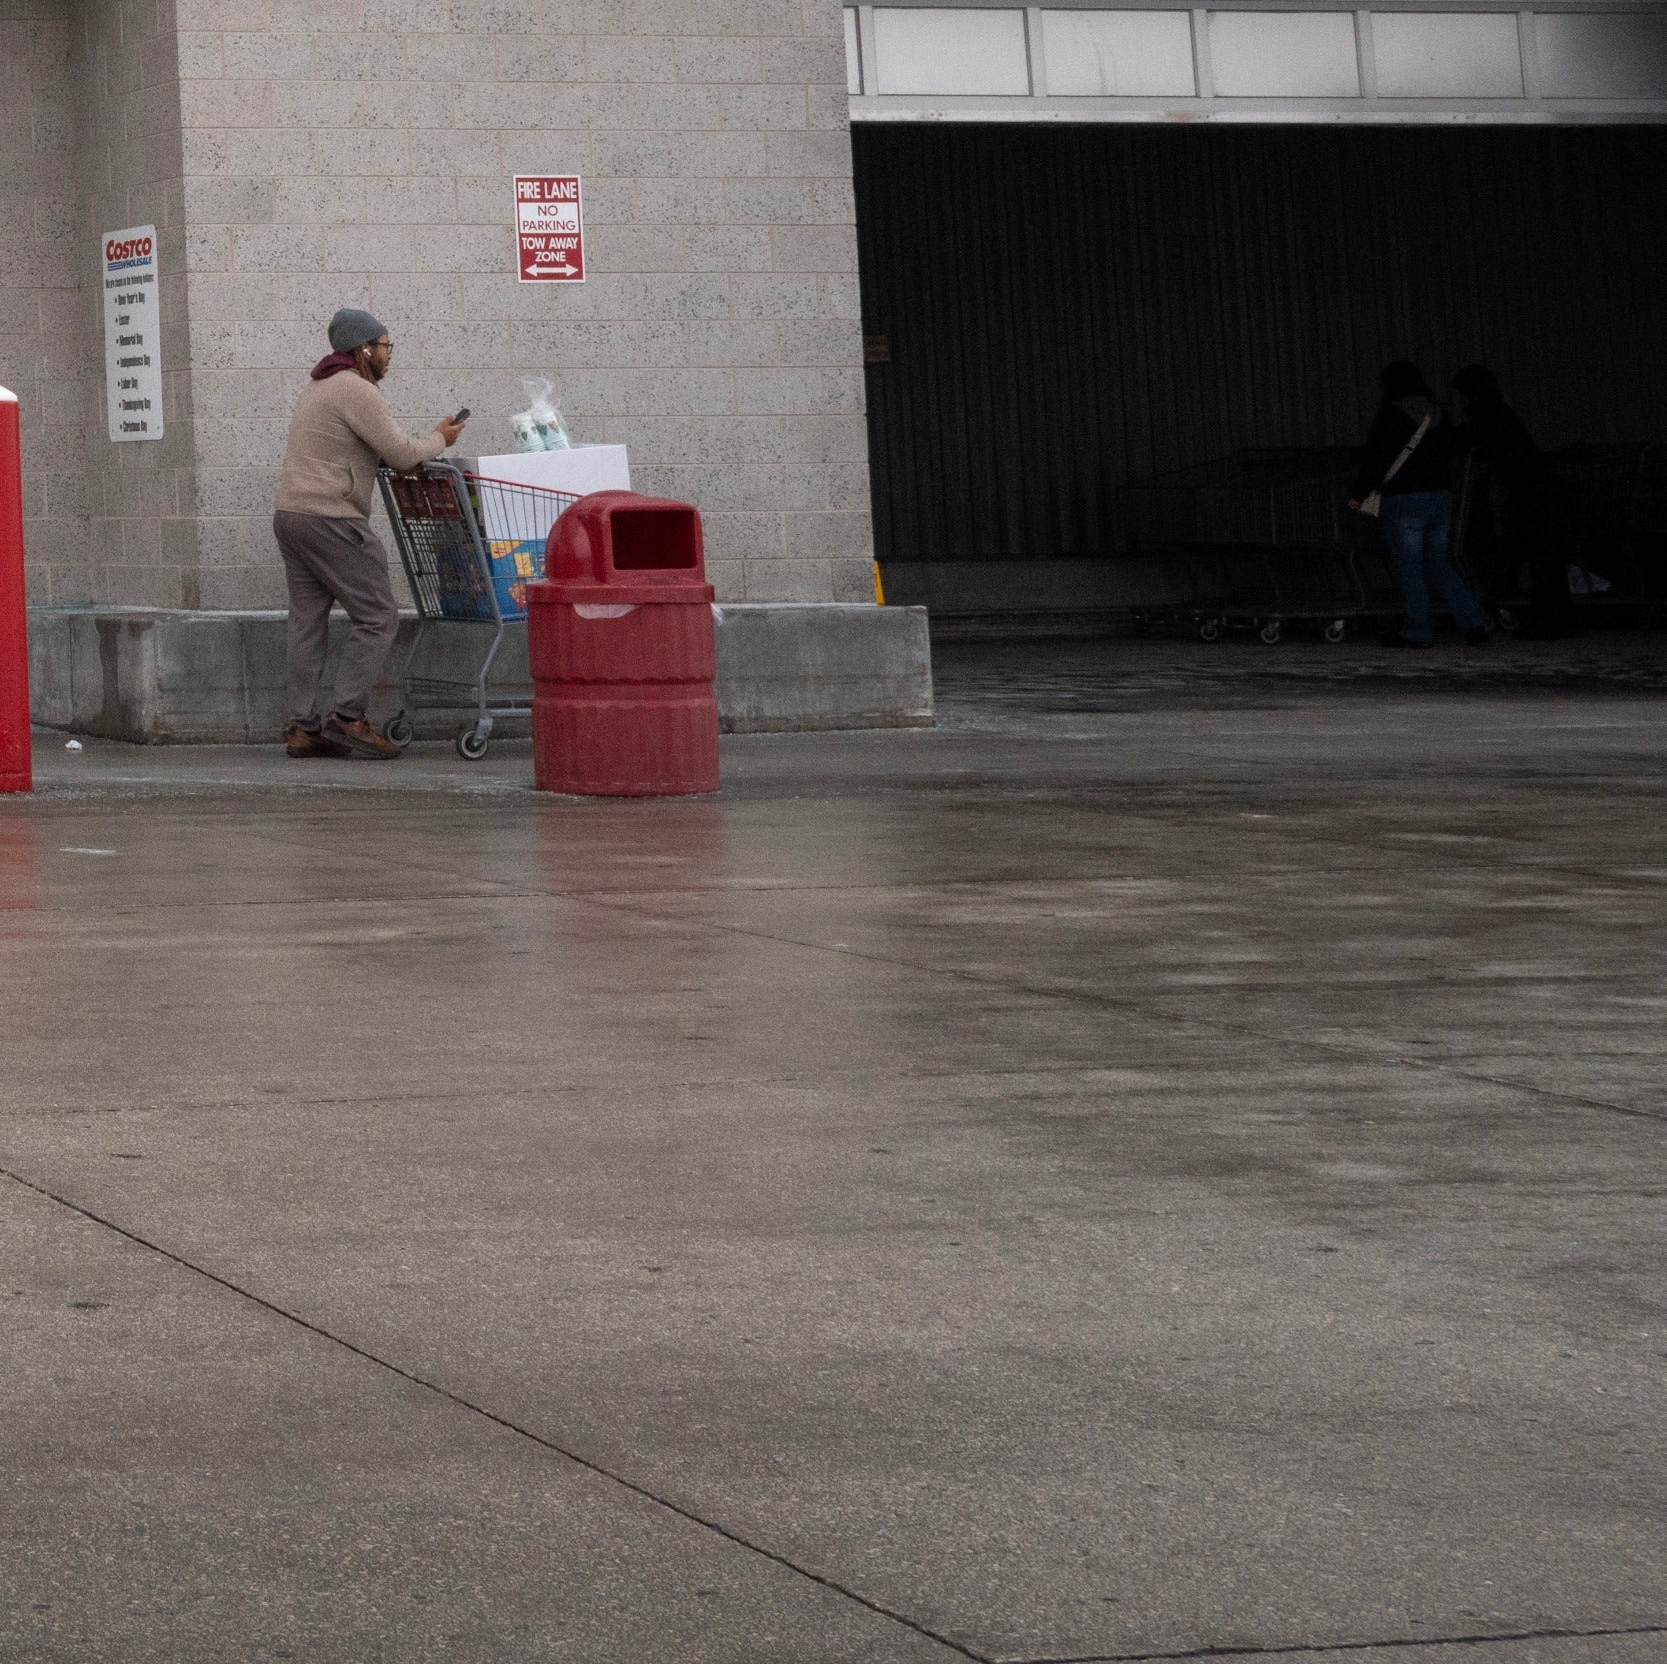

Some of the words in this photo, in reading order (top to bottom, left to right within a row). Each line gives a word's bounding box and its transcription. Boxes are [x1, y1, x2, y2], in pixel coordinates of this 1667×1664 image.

[517, 181, 541, 199] FIRE
[544, 181, 578, 199] LANE
[537, 205, 558, 217] NO
[522, 220, 576, 231] PARKING
[106, 237, 152, 261] COSTCO
[521, 237, 546, 250] TOW
[548, 237, 579, 250] AWAY
[535, 251, 567, 262] ZONE
